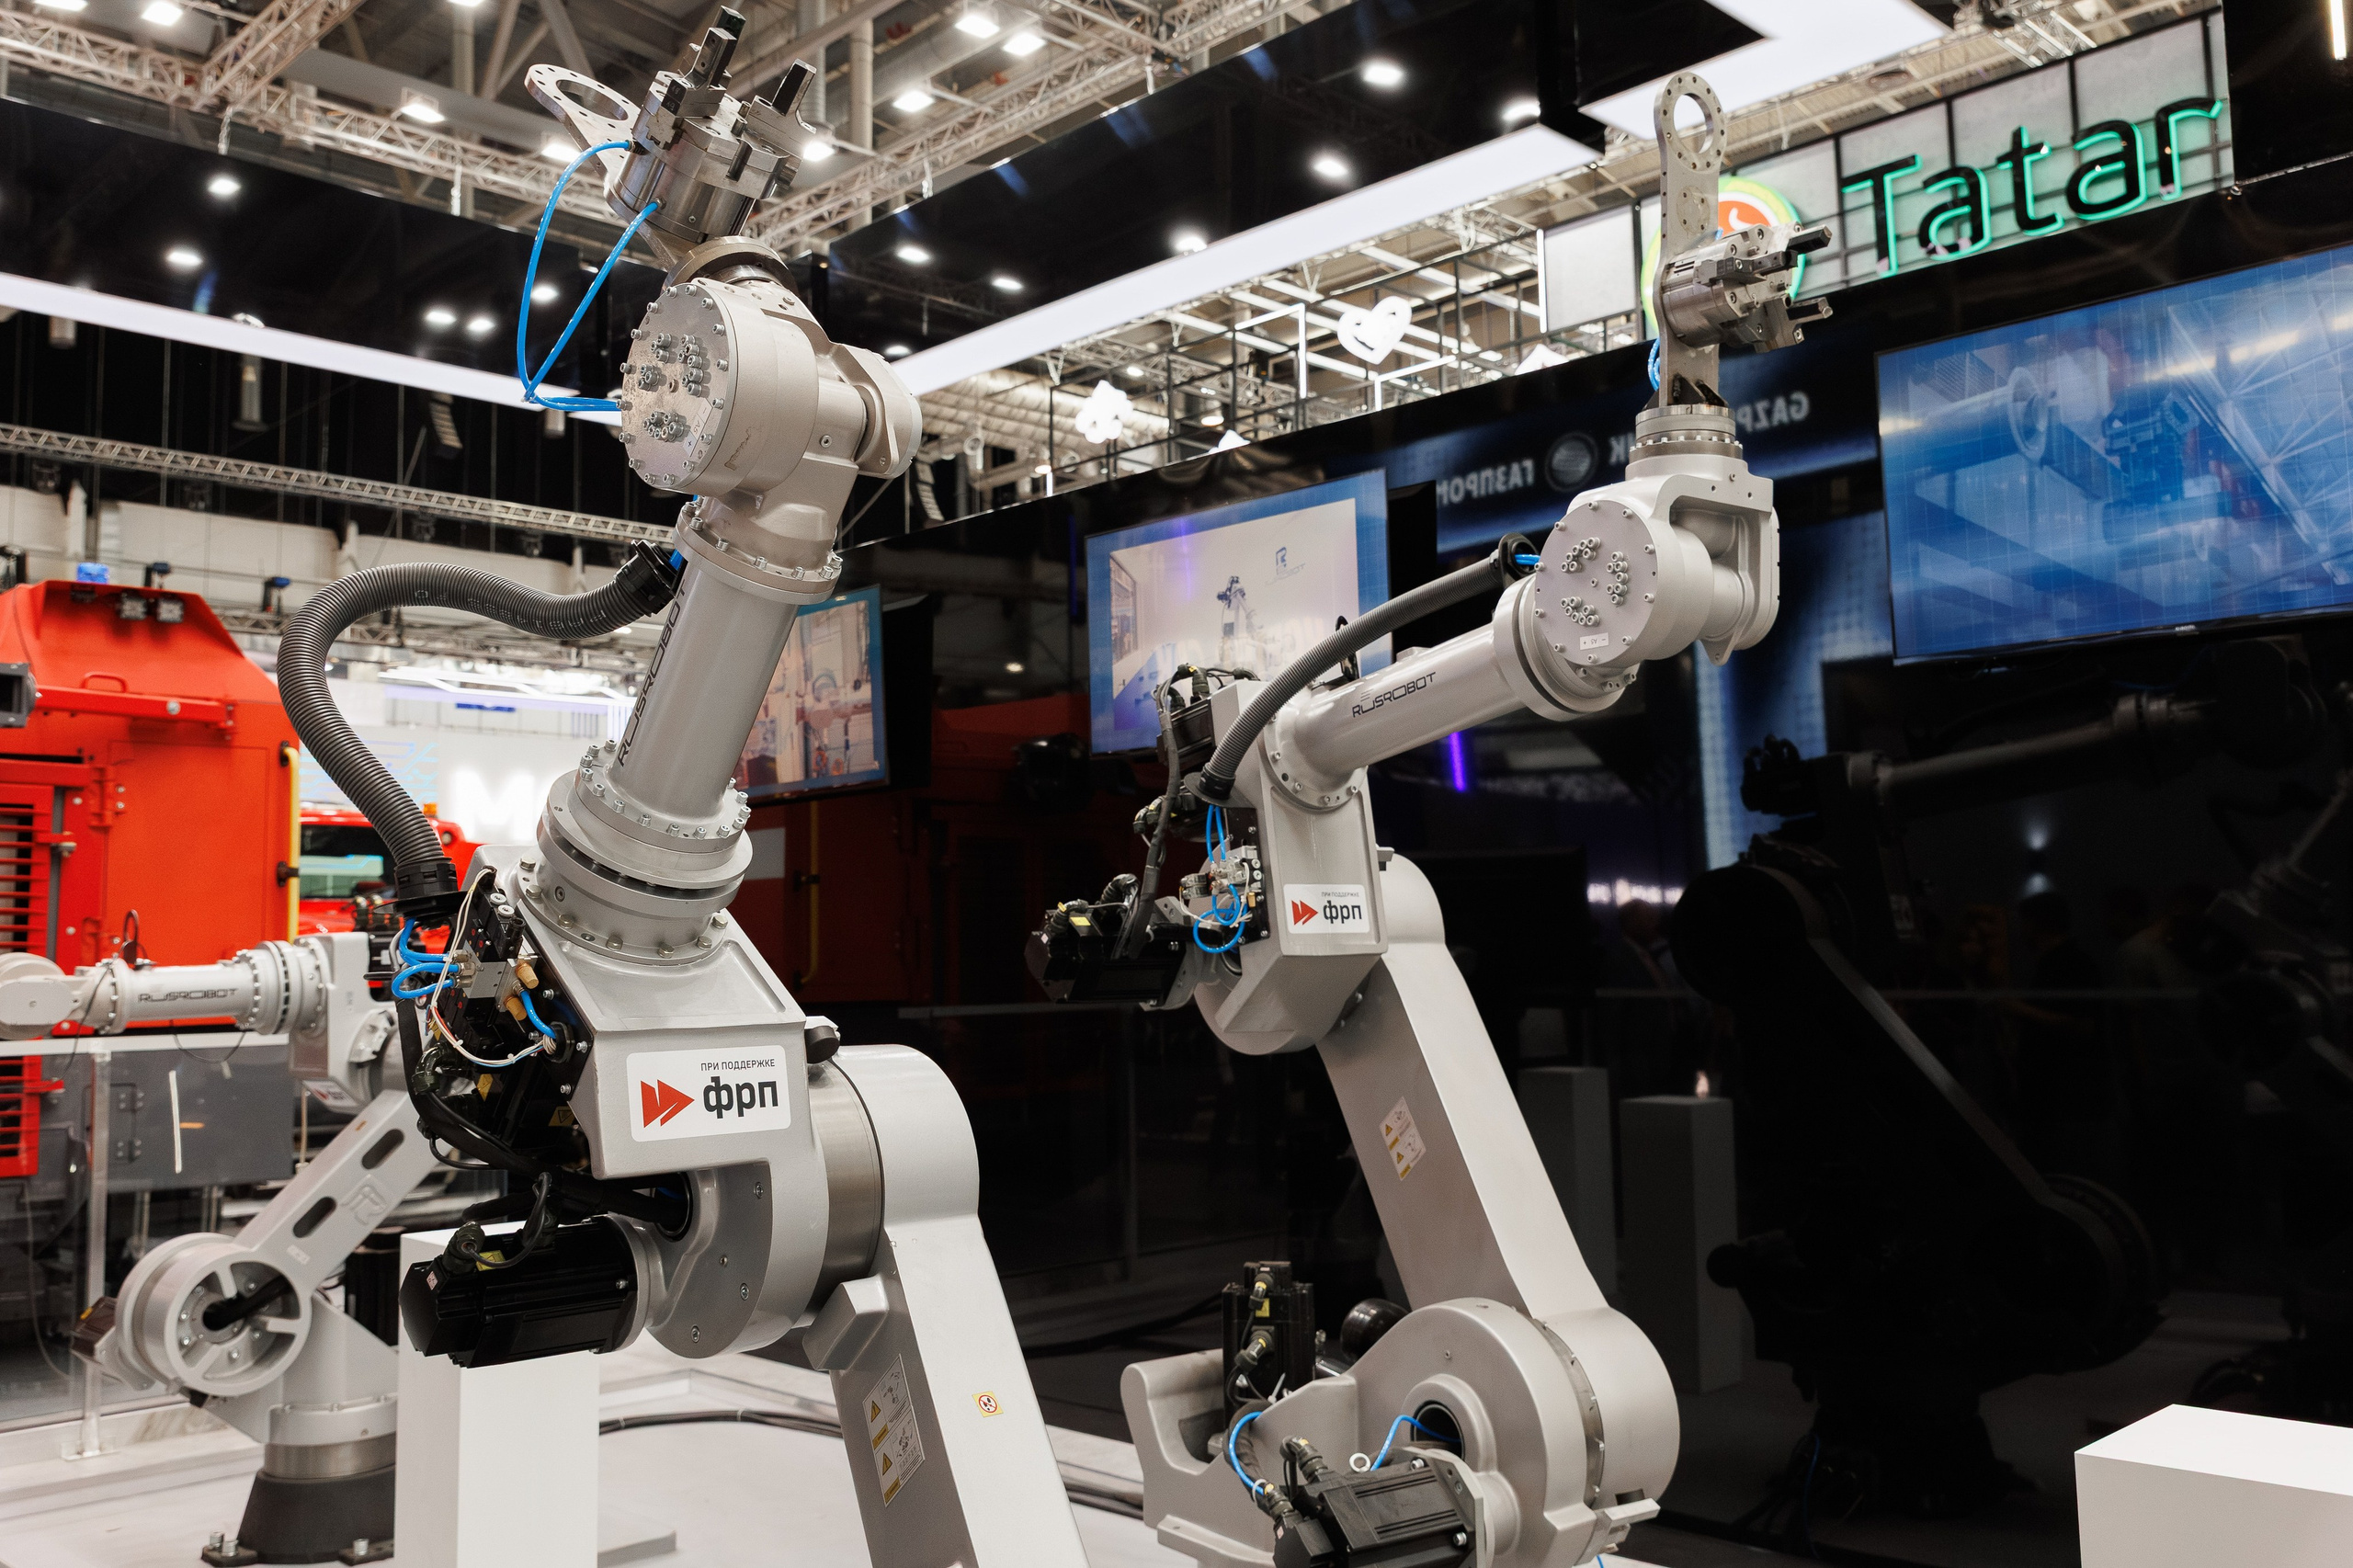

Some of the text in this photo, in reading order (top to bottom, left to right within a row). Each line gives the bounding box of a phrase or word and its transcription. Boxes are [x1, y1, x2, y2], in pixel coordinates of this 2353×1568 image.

[1842, 97, 2223, 278] Tatar
[617, 579, 687, 767] RUSROBOT
[1352, 672, 1436, 718] RUSROBOT
[1323, 900, 1362, 925] фрп
[138, 987, 238, 1003] RUSROBOT
[700, 1058, 776, 1072] ПРИ ПОДДЕРЖКЕ
[703, 1075, 779, 1119] фрп
